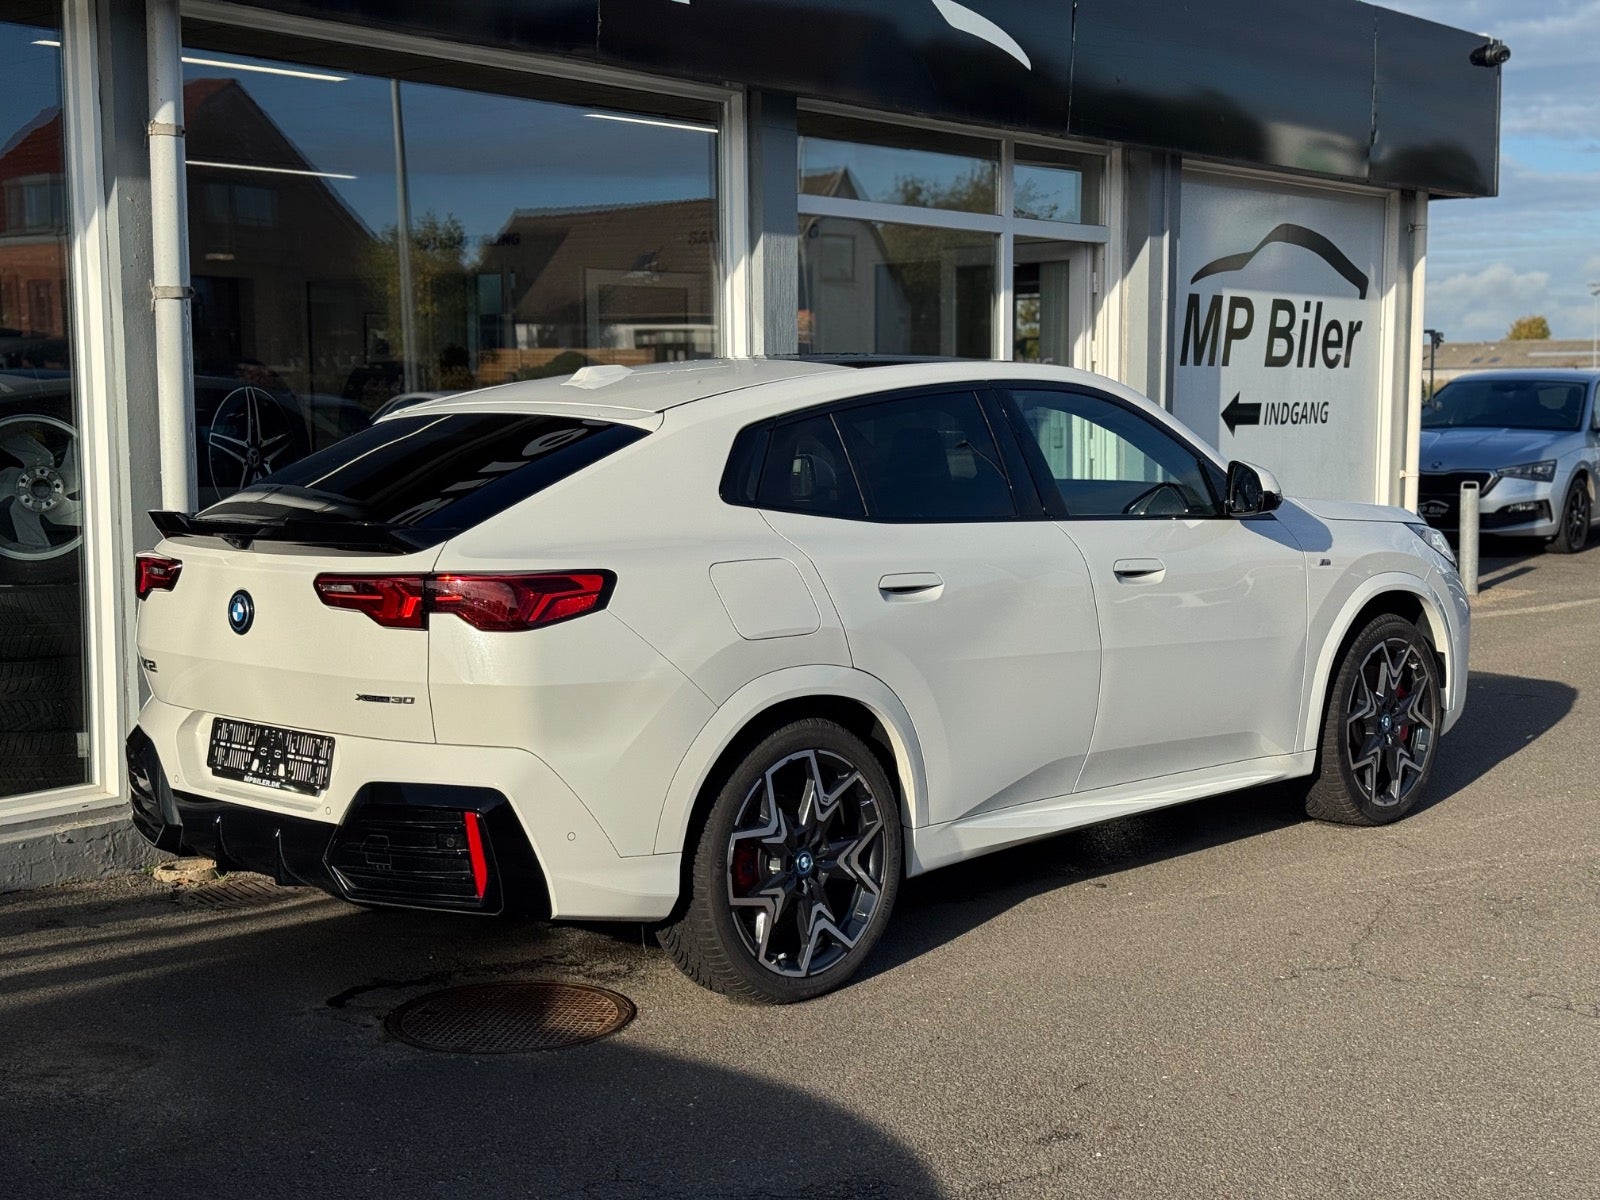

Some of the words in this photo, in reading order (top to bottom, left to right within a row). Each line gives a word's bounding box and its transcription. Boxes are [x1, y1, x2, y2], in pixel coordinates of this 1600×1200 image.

[1179, 293, 1255, 367] MP
[1264, 298, 1363, 369] Biler
[1264, 402, 1329, 425] INDGANG
